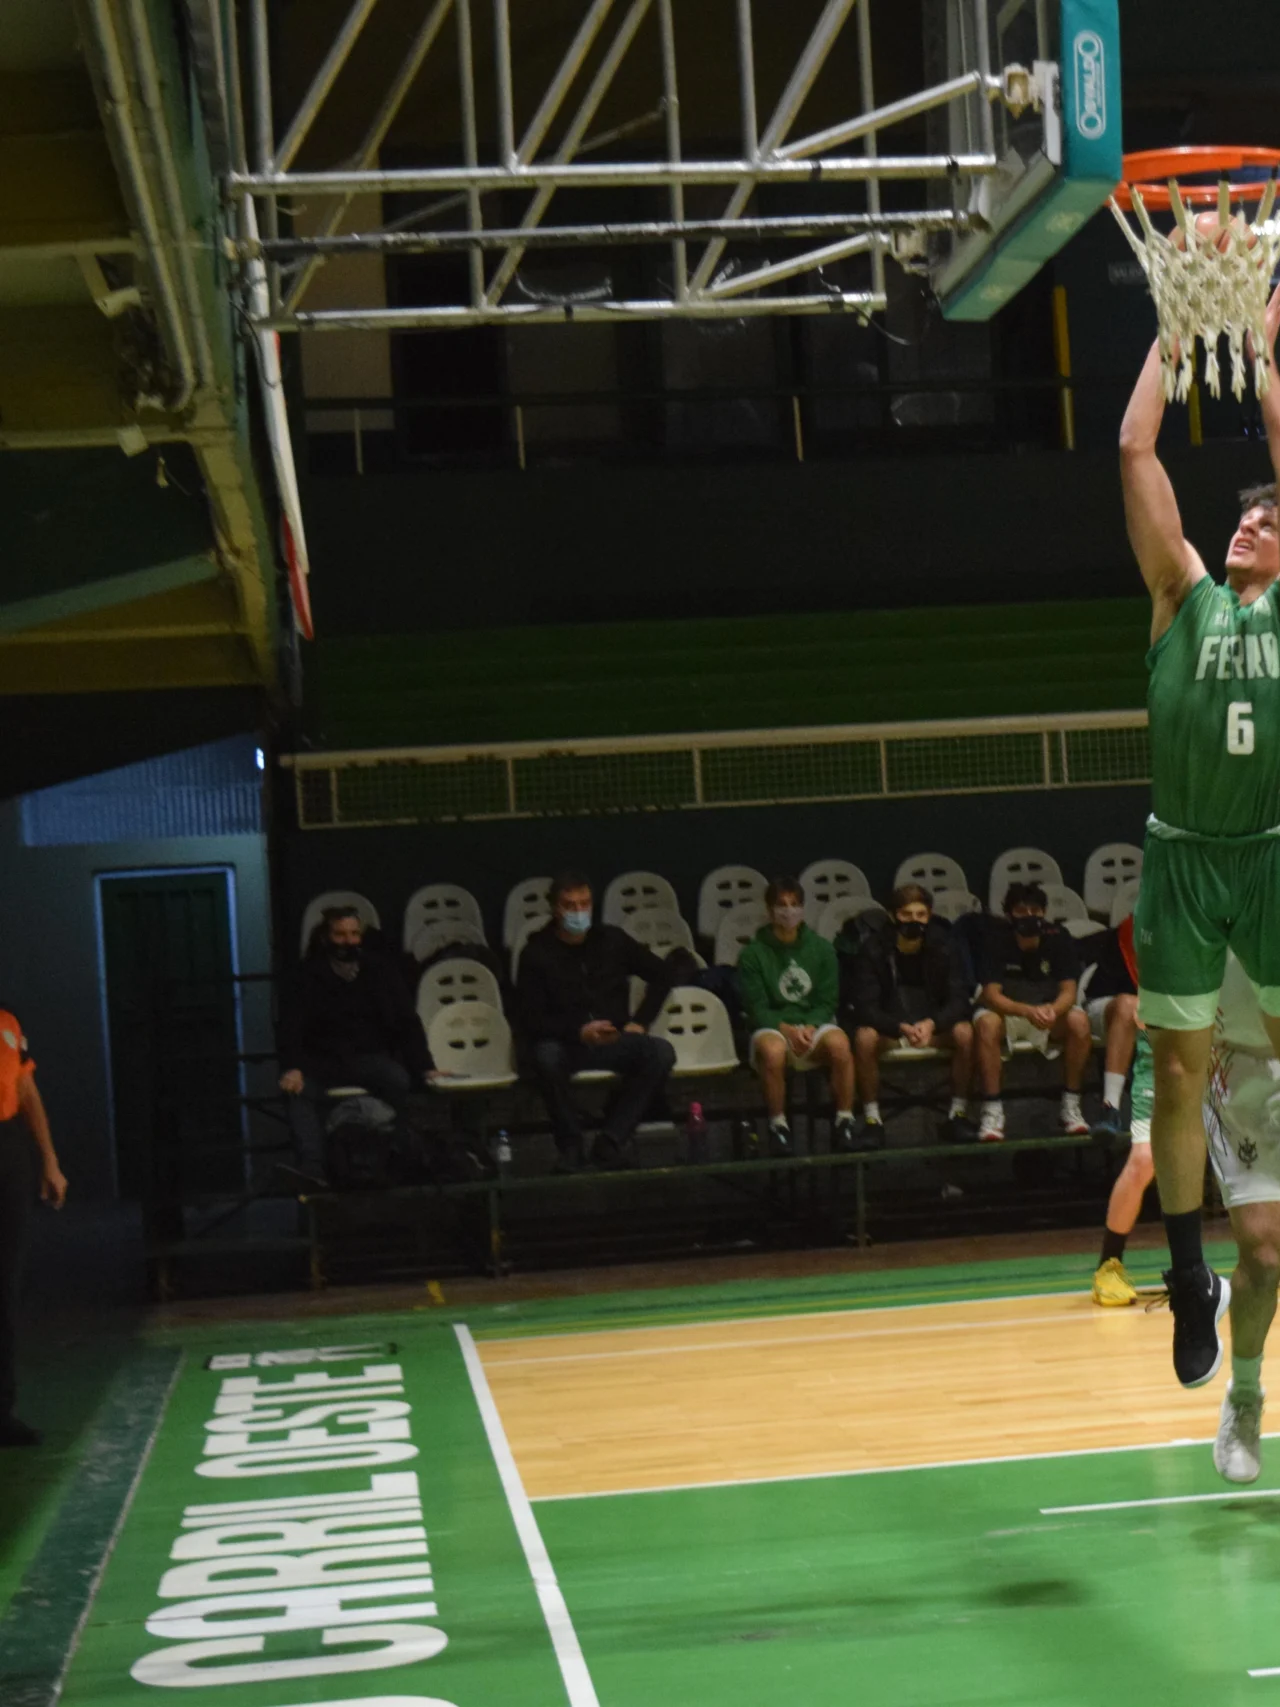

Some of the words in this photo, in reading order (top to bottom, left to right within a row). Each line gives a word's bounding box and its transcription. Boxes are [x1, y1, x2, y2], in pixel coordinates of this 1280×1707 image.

[1195, 631, 1280, 680] FERRO
[1227, 701, 1255, 755] 6
[194, 1363, 420, 1479] OESTE
[129, 1470, 449, 1688] CARRIL
